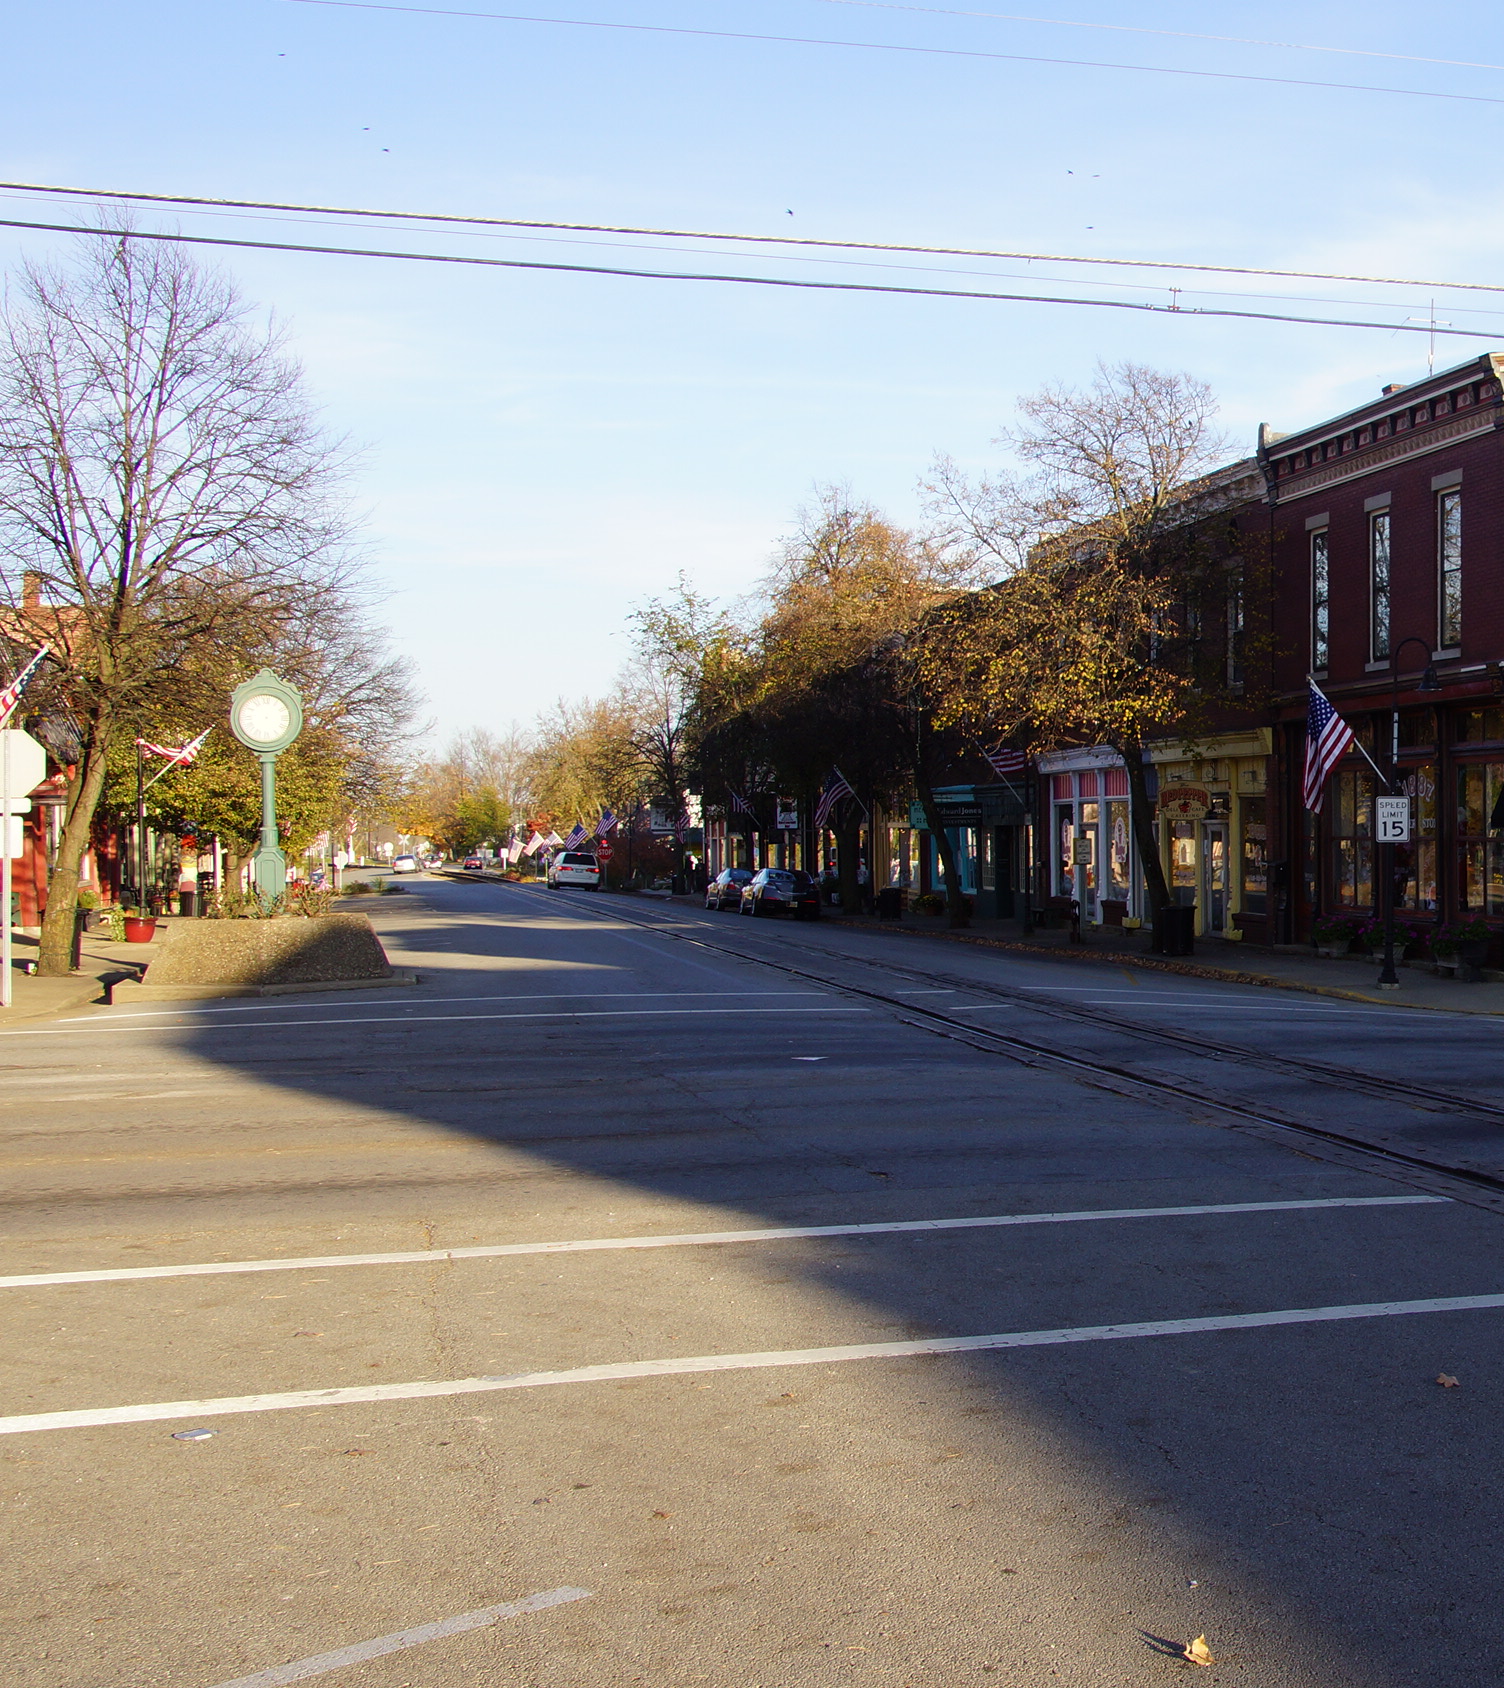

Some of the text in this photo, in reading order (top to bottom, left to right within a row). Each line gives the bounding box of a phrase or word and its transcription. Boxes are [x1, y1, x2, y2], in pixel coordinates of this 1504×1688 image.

[1401, 774, 1435, 802] 1887
[1382, 820, 1404, 837] 15
[598, 848, 613, 856] STOP
